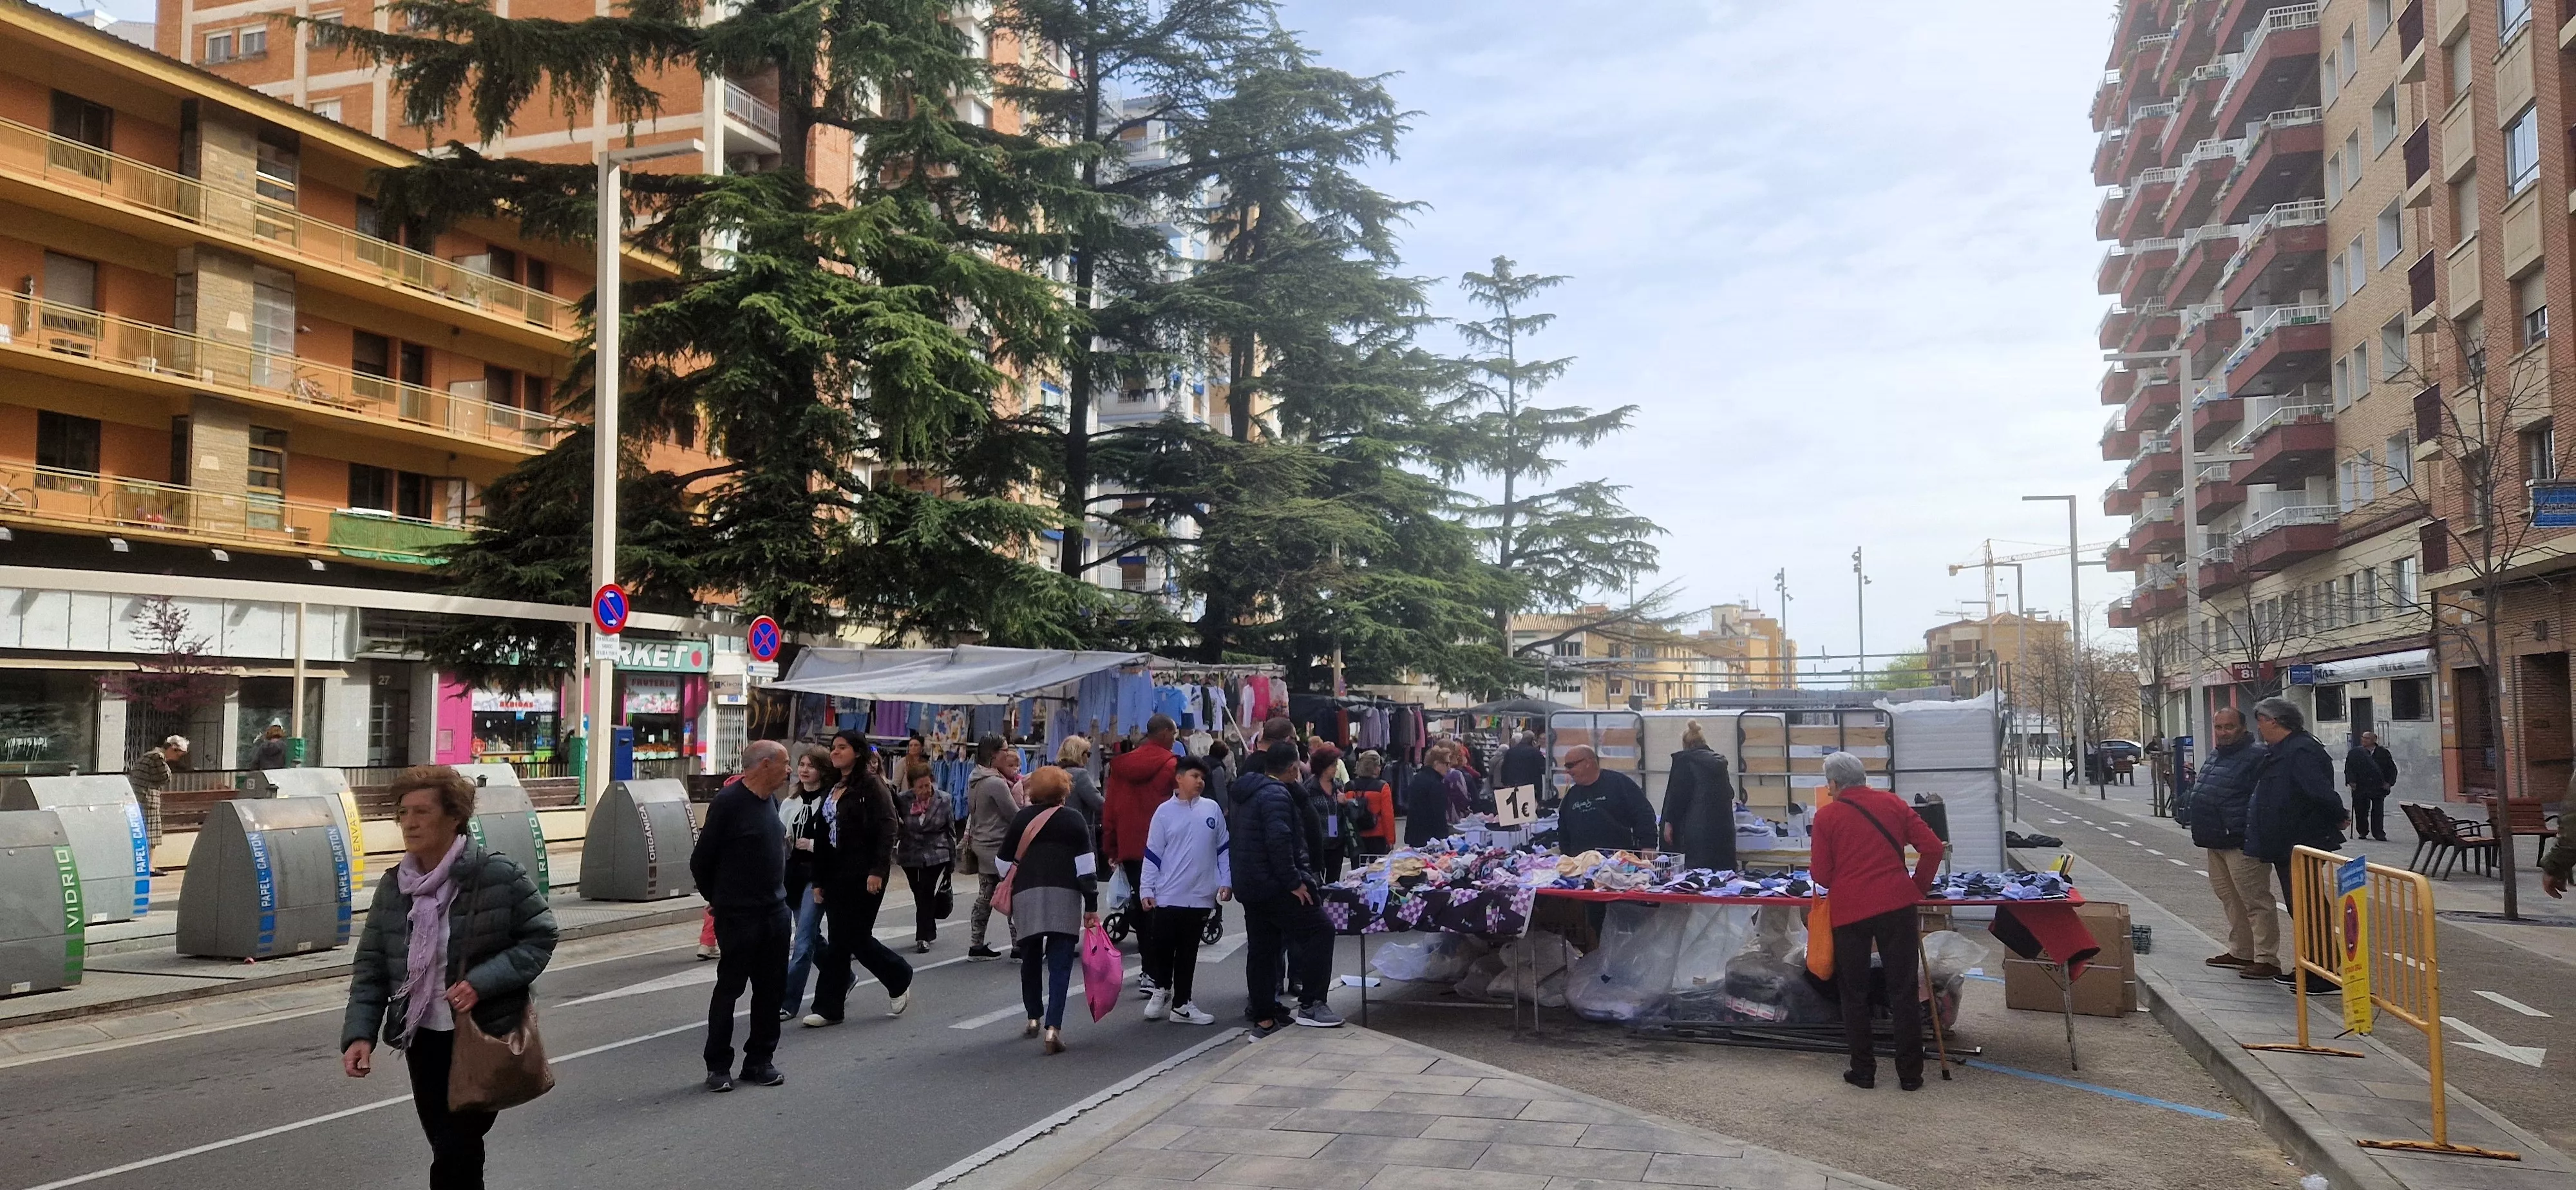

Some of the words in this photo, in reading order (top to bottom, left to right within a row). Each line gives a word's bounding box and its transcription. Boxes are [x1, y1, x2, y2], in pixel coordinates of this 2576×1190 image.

[613, 641, 688, 668] RKET
[378, 675, 390, 685] 27
[632, 679, 676, 687] FRUTERIA
[638, 805, 656, 860] ORGANICA
[685, 804, 699, 846] GANICA
[137, 845, 146, 873] PAPEL
[251, 833, 267, 869] CARTON
[329, 827, 344, 862] CARTON
[528, 817, 547, 872] RESTO
[56, 849, 79, 929] VIDRIO
[260, 878, 271, 907] PAPEL
[337, 871, 348, 898] PAPEL
